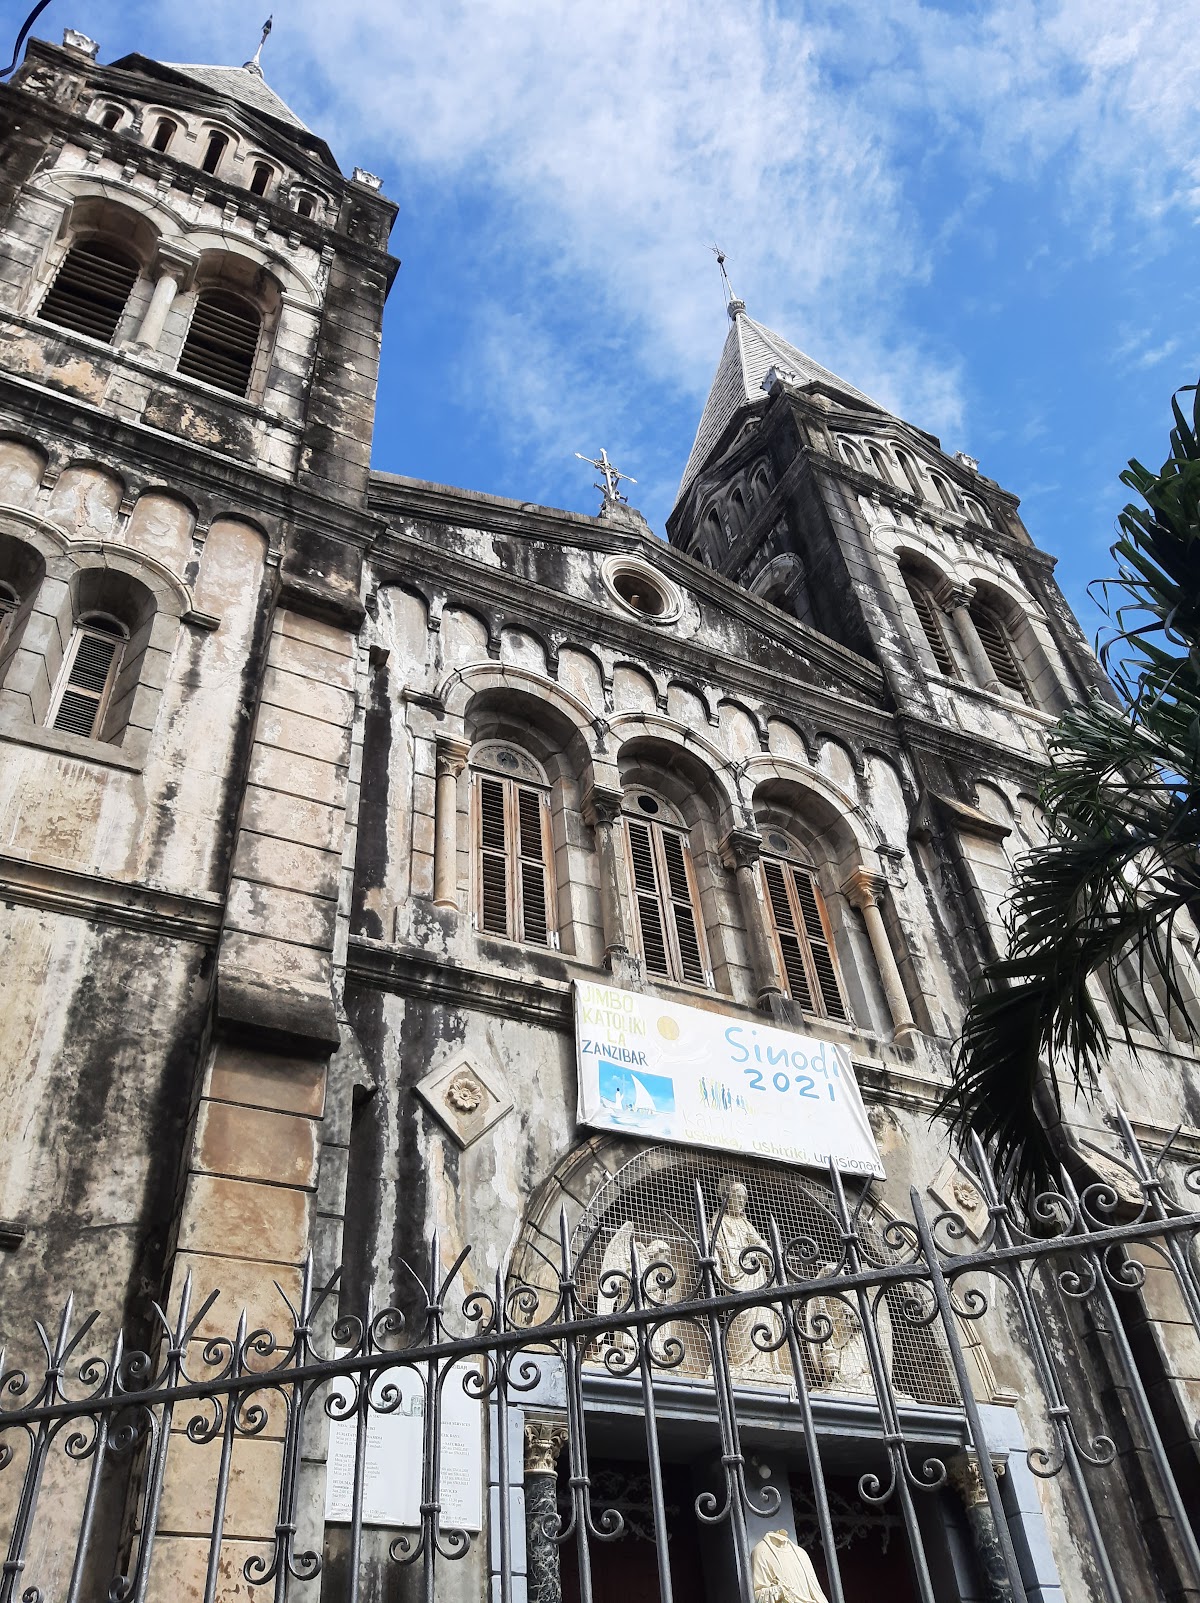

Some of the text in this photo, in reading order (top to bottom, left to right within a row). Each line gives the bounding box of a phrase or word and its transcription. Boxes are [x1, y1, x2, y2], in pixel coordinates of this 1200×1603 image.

[582, 985, 634, 1013] JIMBO
[582, 1006, 647, 1038] KATOLIKI
[581, 1039, 649, 1067] ZANZIBAR
[607, 1029, 626, 1047] LA
[724, 1026, 840, 1080] Sinodi
[743, 1068, 836, 1102] 2021
